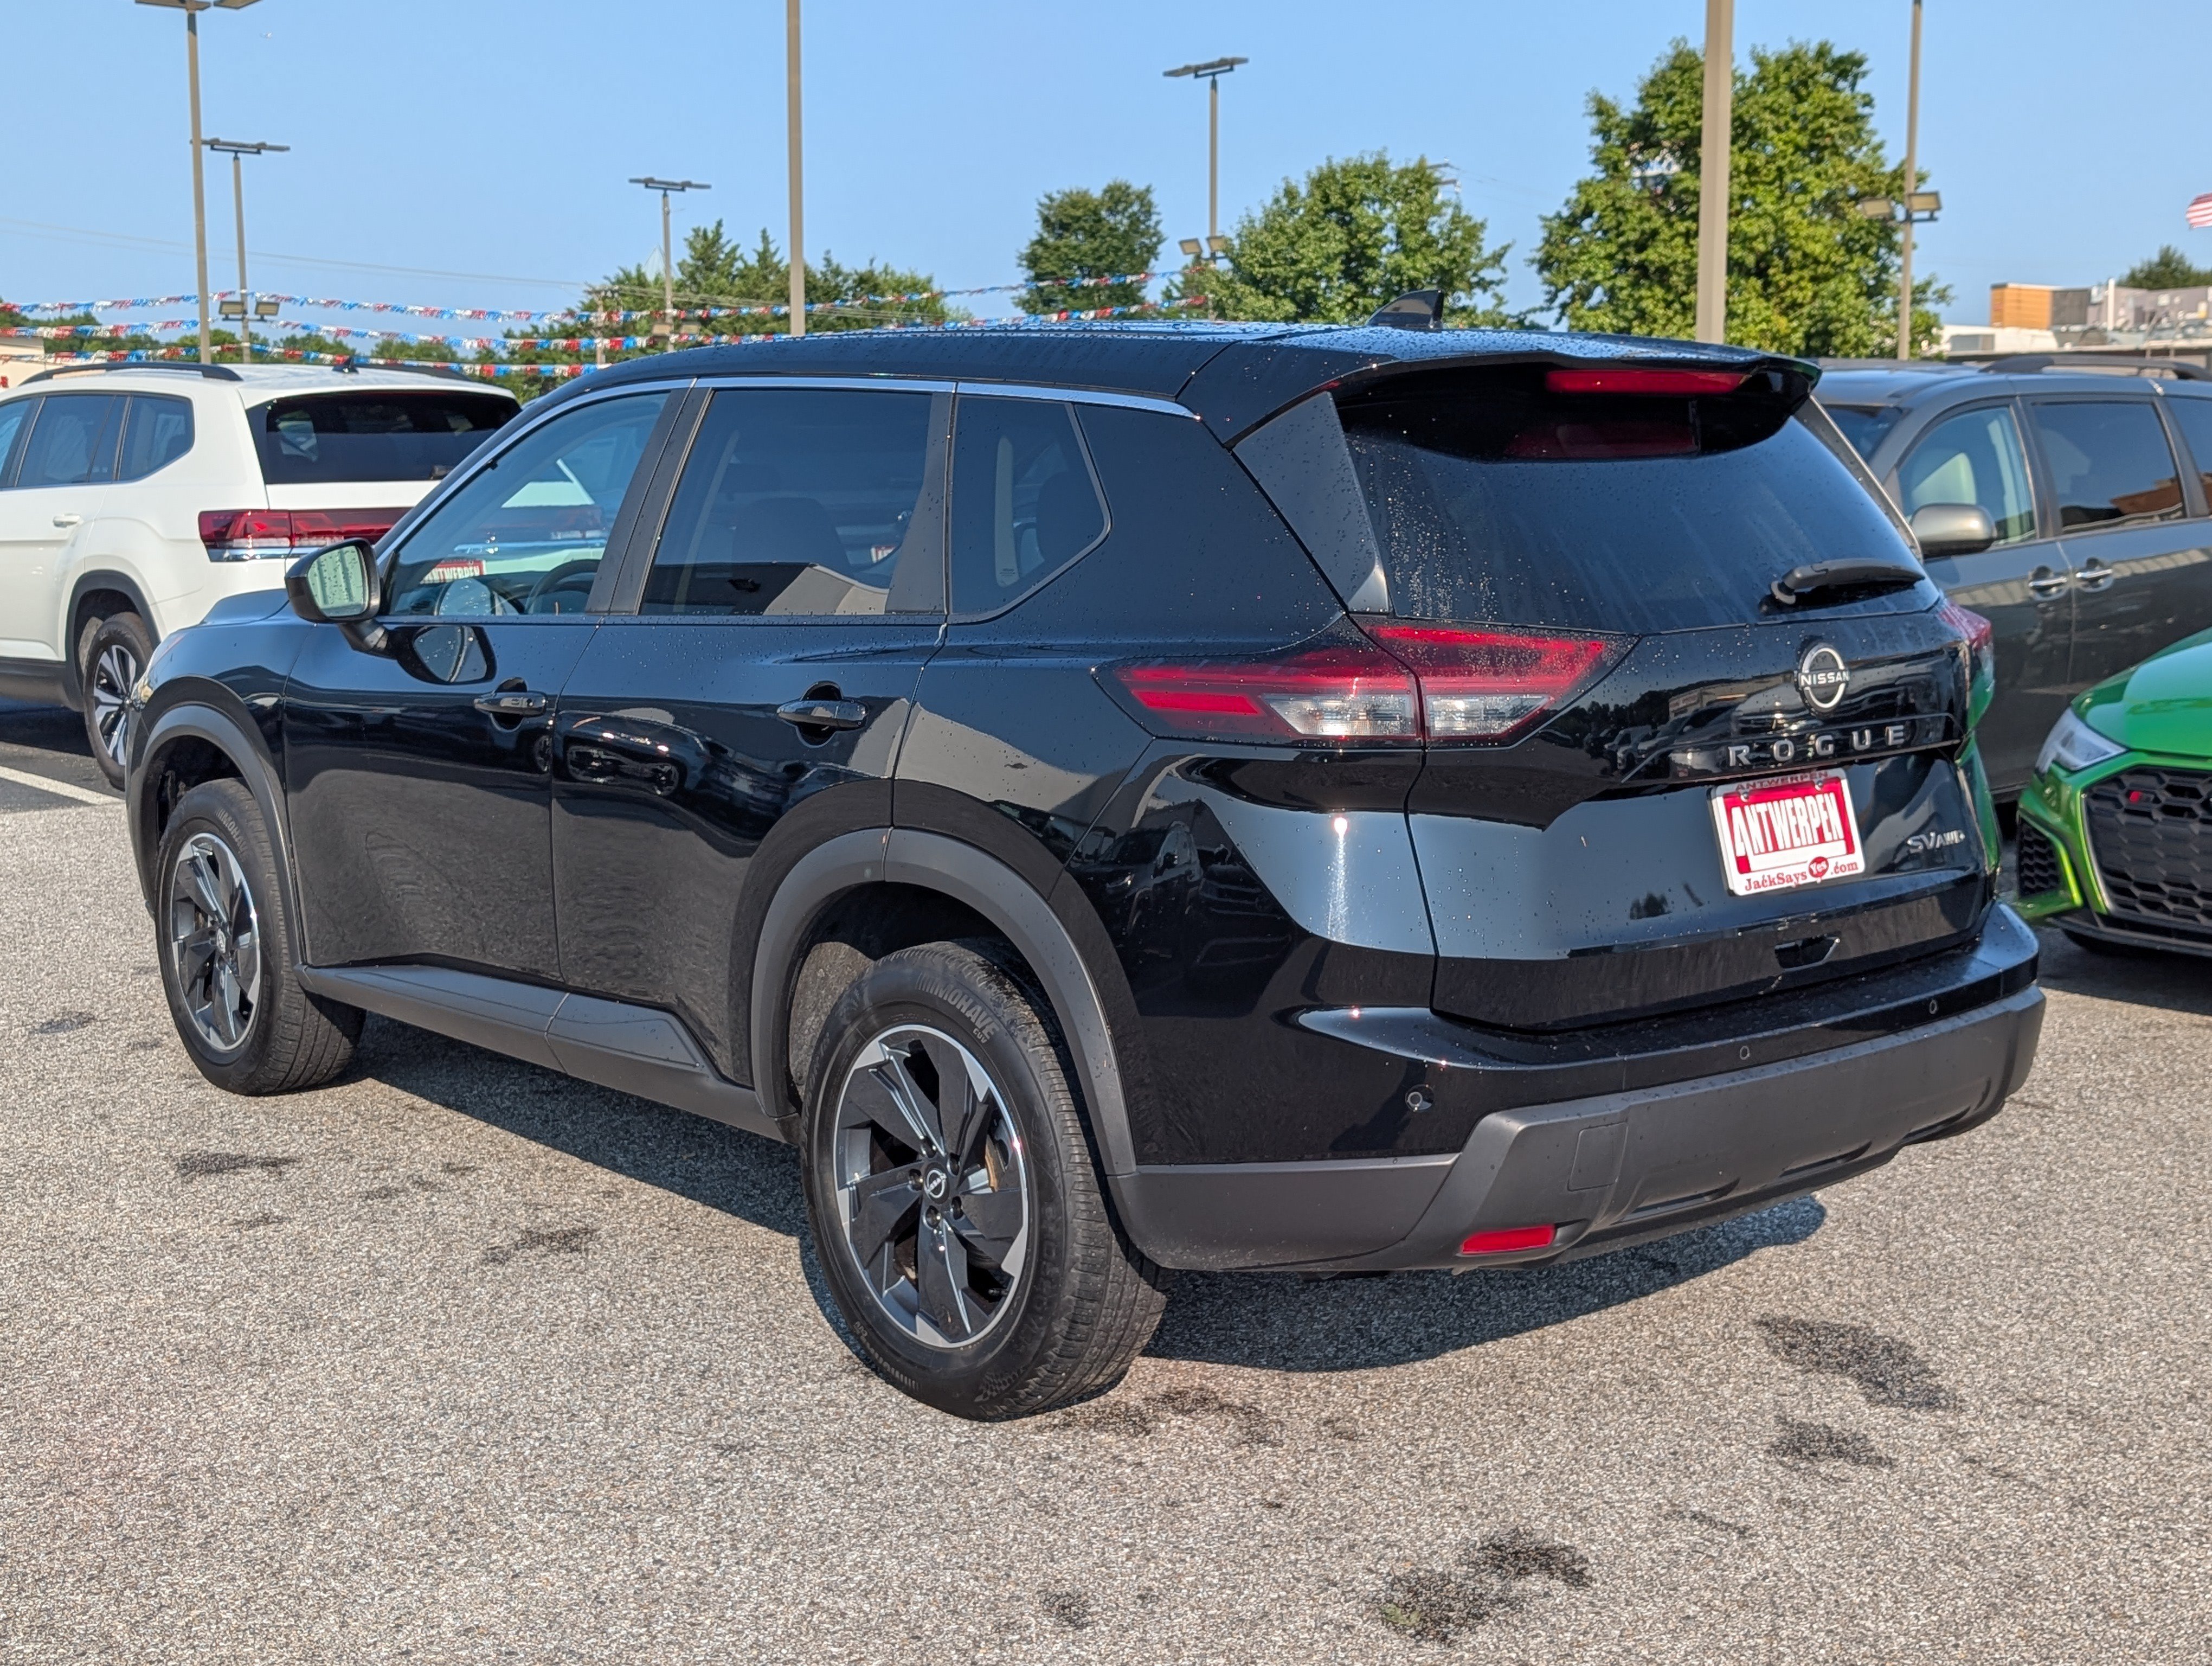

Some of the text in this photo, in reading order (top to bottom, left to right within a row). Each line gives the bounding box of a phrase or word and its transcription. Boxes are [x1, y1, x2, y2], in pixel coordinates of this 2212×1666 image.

[1800, 671, 1850, 686] NISSAN
[1728, 725, 1904, 767] ROGUE
[1735, 772, 1829, 792] ANTWERPEN
[1731, 792, 1844, 856] ANTWERPEN
[1907, 832, 1935, 854] SV
[1744, 870, 1808, 892] JackSays
[934, 984, 1000, 1040] MOHAVE
[973, 1027, 987, 1044] CUV
